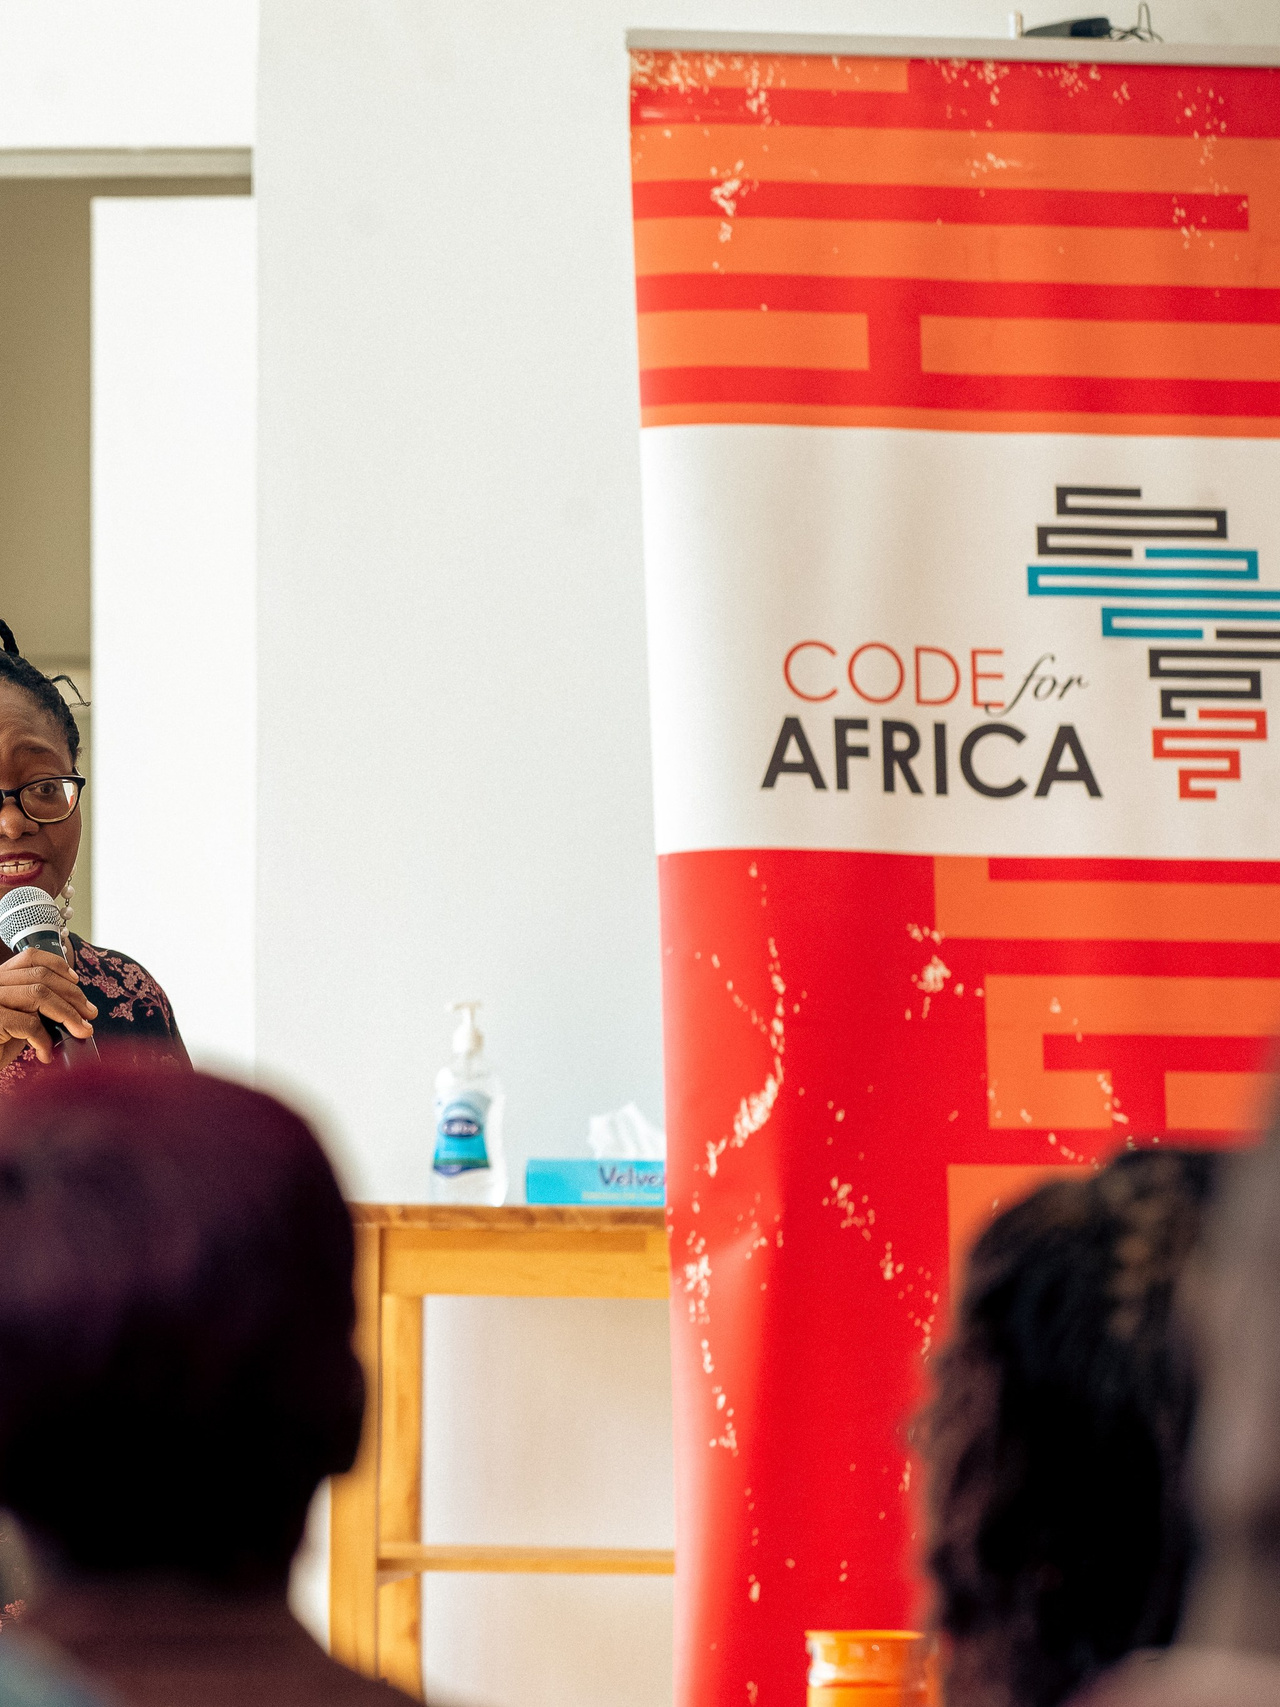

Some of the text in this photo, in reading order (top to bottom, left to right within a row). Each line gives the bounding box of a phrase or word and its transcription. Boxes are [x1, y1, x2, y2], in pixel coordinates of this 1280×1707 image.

[783, 640, 1089, 717] CODE for
[761, 716, 1104, 799] AFRICA
[599, 1165, 665, 1187] Velve
